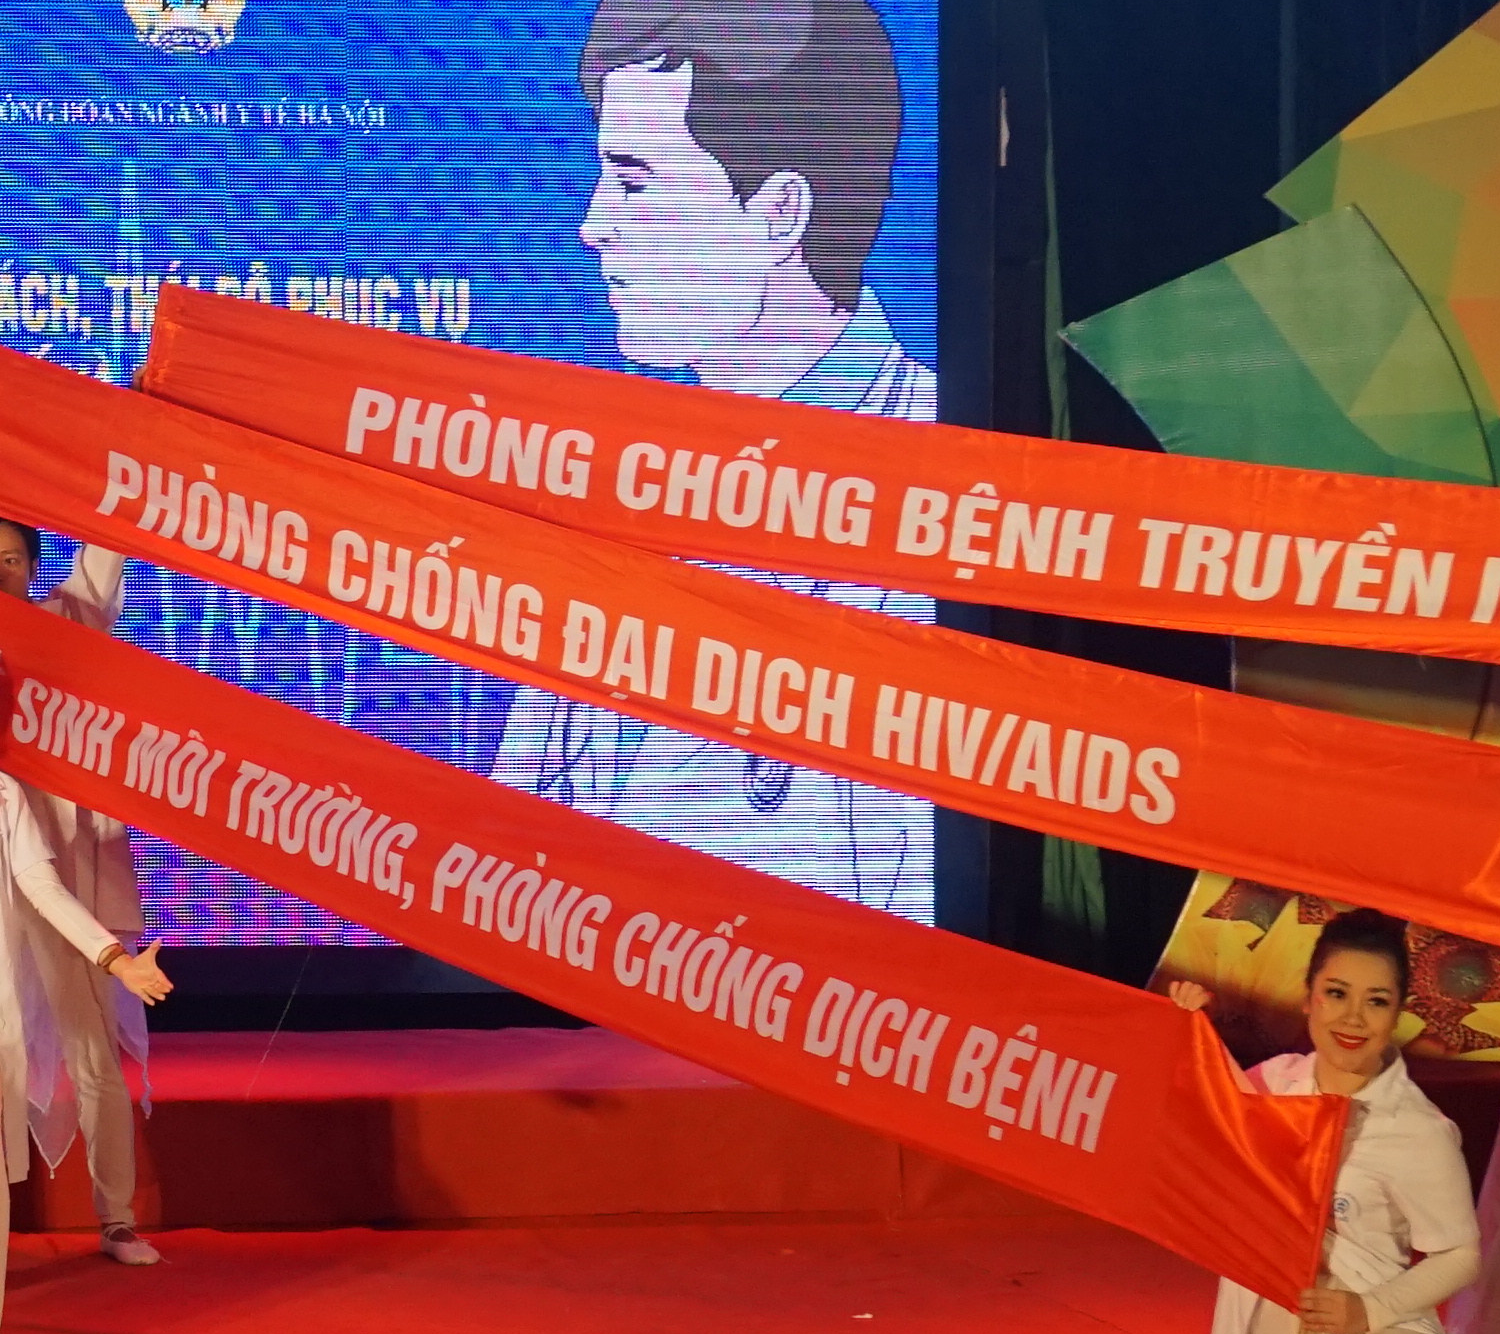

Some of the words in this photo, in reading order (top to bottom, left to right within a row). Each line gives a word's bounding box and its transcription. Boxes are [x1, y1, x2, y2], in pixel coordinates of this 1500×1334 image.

[97, 450, 309, 581] PHÒNG
[327, 529, 544, 659] CHỐNG
[561, 599, 675, 701] ĐẠI
[691, 636, 856, 748] DỊCH
[871, 684, 1181, 825] HIV/AIDS
[345, 386, 596, 499] PHÒNG
[615, 437, 876, 547] CHỐNG
[896, 482, 1114, 581] BỆNH
[1138, 521, 1455, 619] TRUYỀN
[12, 678, 126, 777] SINH
[123, 720, 227, 818] MÔI
[226, 759, 418, 912] TRƯỜNG,
[430, 842, 613, 971] PHÒNG
[612, 912, 804, 1043] CHỐNG
[802, 976, 945, 1094] DỊCH
[947, 1024, 1118, 1153] BỆNH
